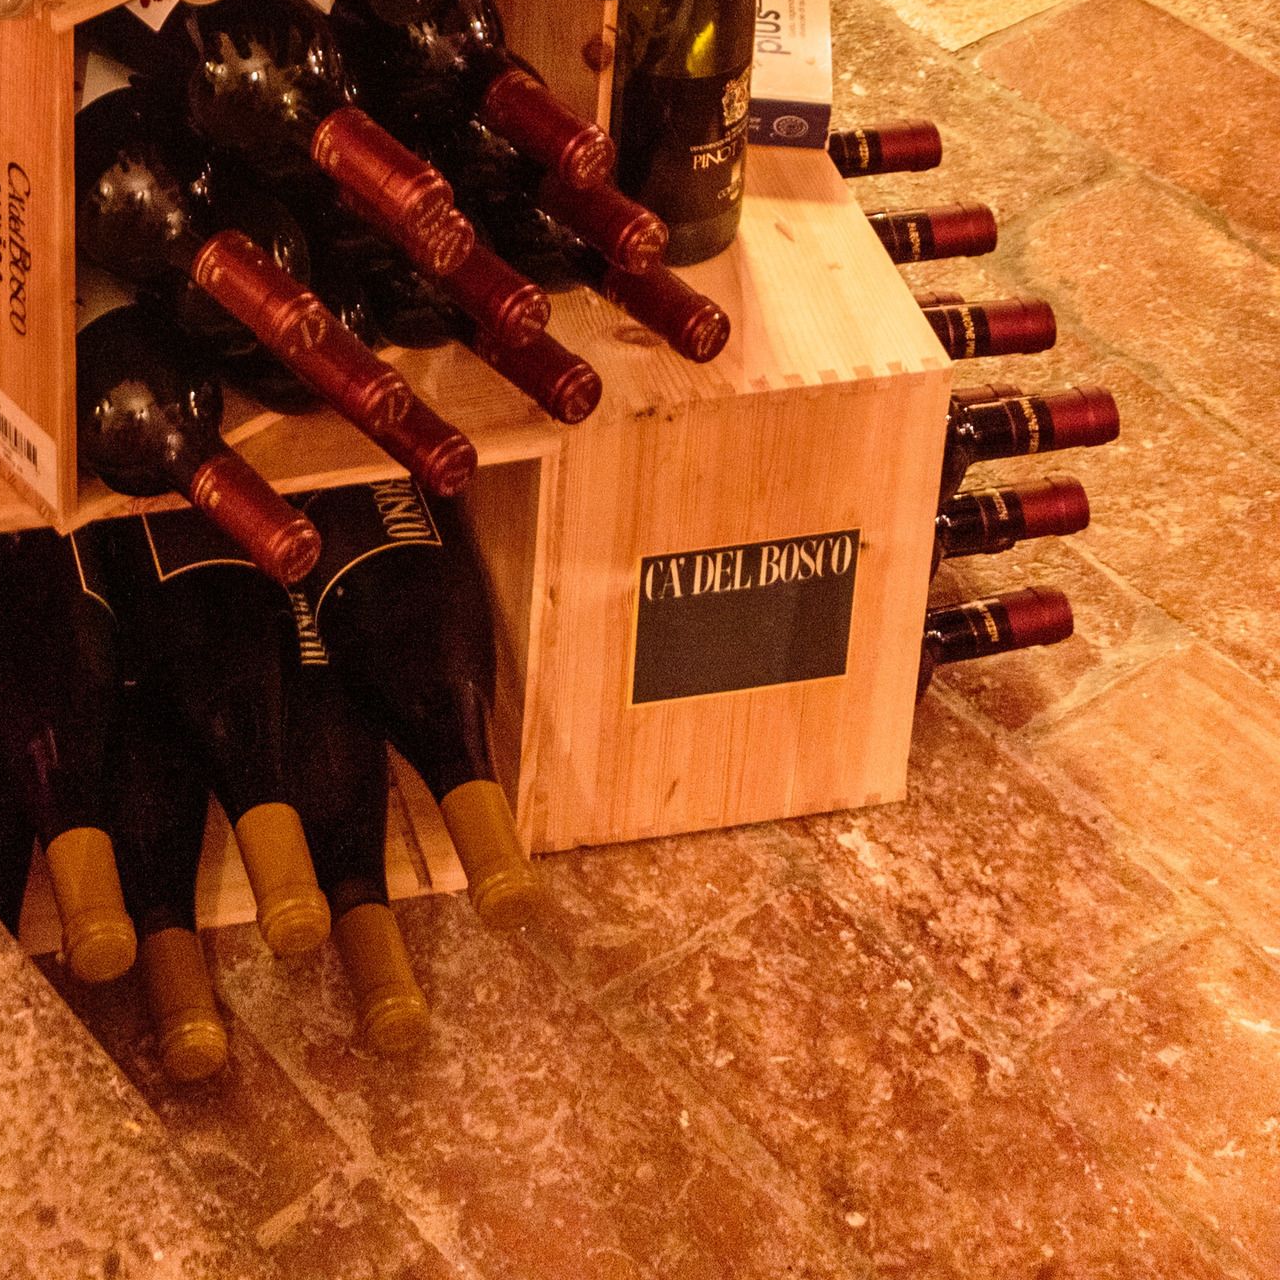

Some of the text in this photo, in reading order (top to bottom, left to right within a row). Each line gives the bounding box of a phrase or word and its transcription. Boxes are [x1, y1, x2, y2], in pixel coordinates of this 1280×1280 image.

[693, 141, 737, 170] PINOT
[645, 535, 853, 601] CA' DEL BOSCO
